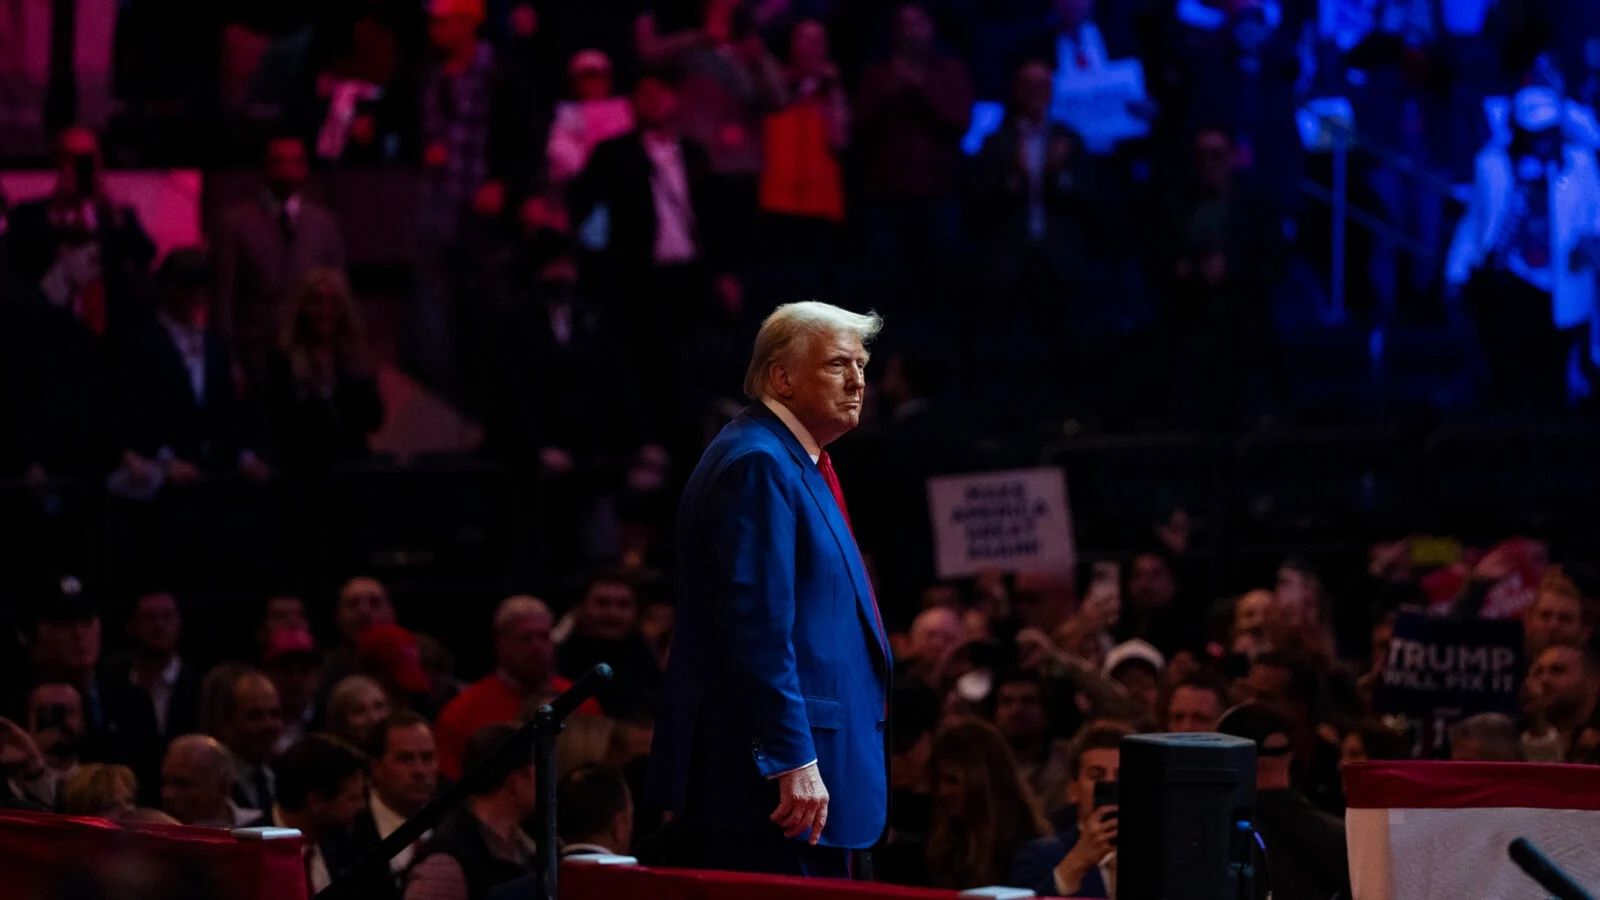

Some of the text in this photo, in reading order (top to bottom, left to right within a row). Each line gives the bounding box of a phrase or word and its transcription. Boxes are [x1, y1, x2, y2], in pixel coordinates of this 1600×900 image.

[1389, 637, 1516, 672] TRUMP
[1384, 669, 1514, 694] WILL FIX IT
